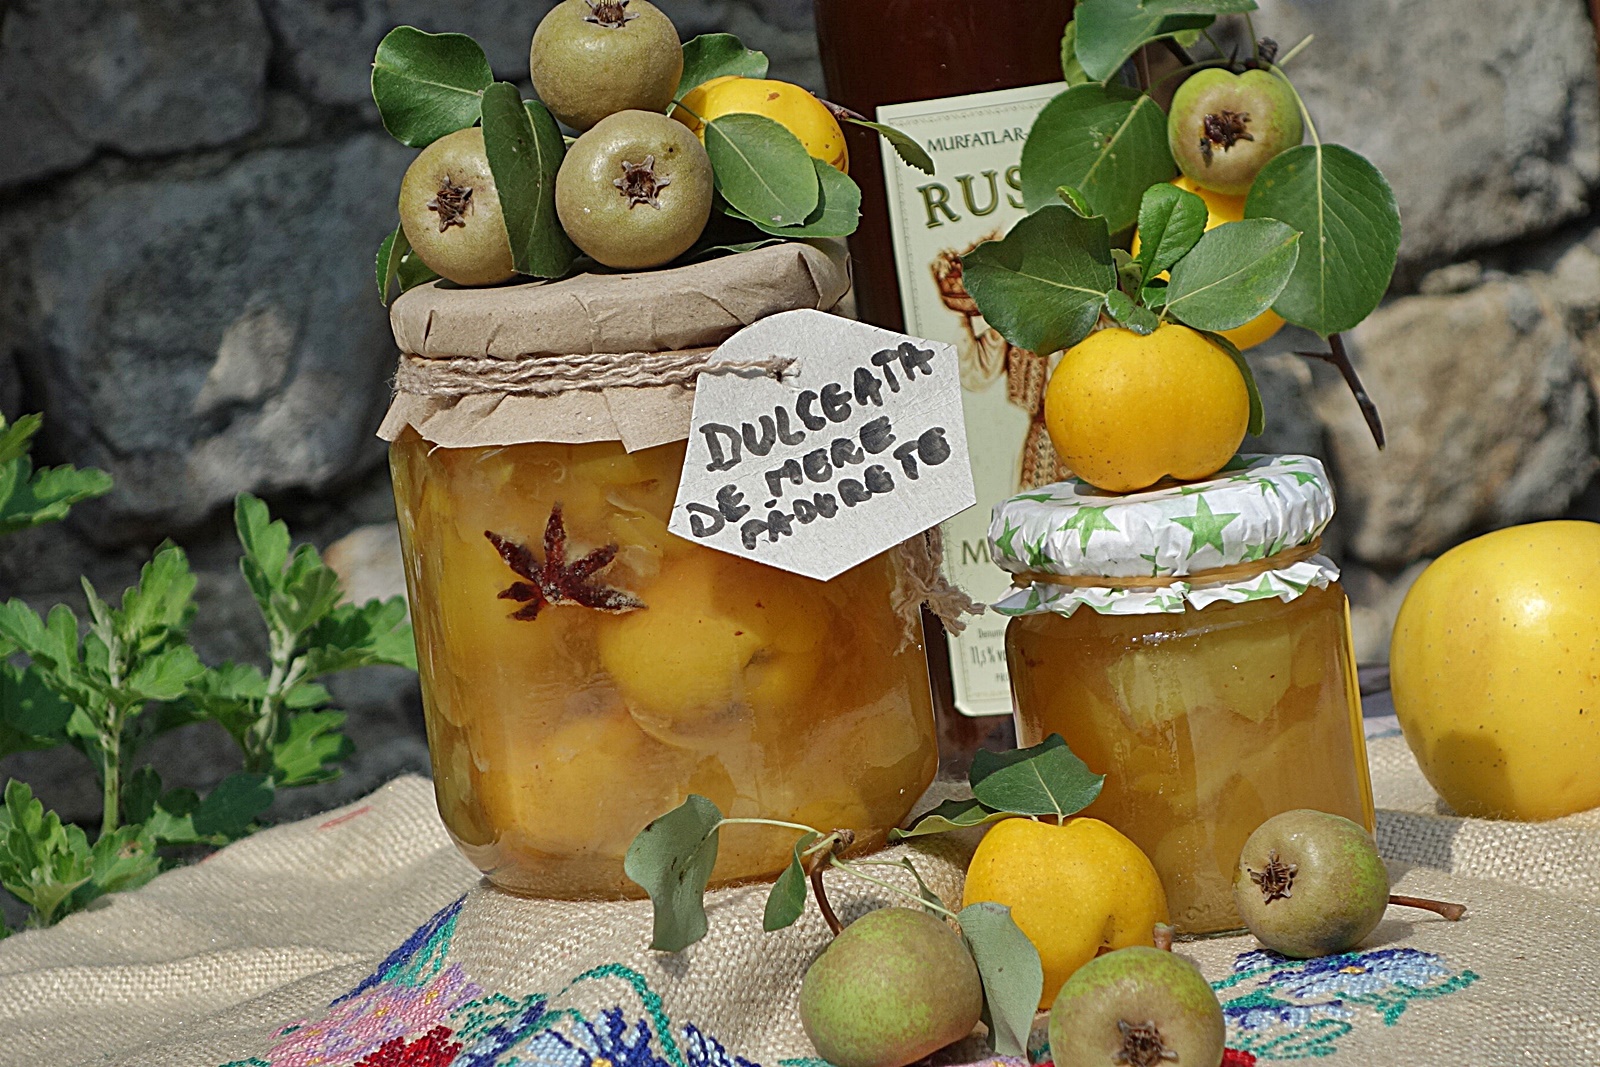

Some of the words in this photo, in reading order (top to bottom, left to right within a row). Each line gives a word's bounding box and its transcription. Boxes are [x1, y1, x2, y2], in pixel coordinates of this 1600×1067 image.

[699, 341, 935, 473] DULCEATA
[685, 484, 751, 538] DE
[764, 415, 896, 498] MERE
